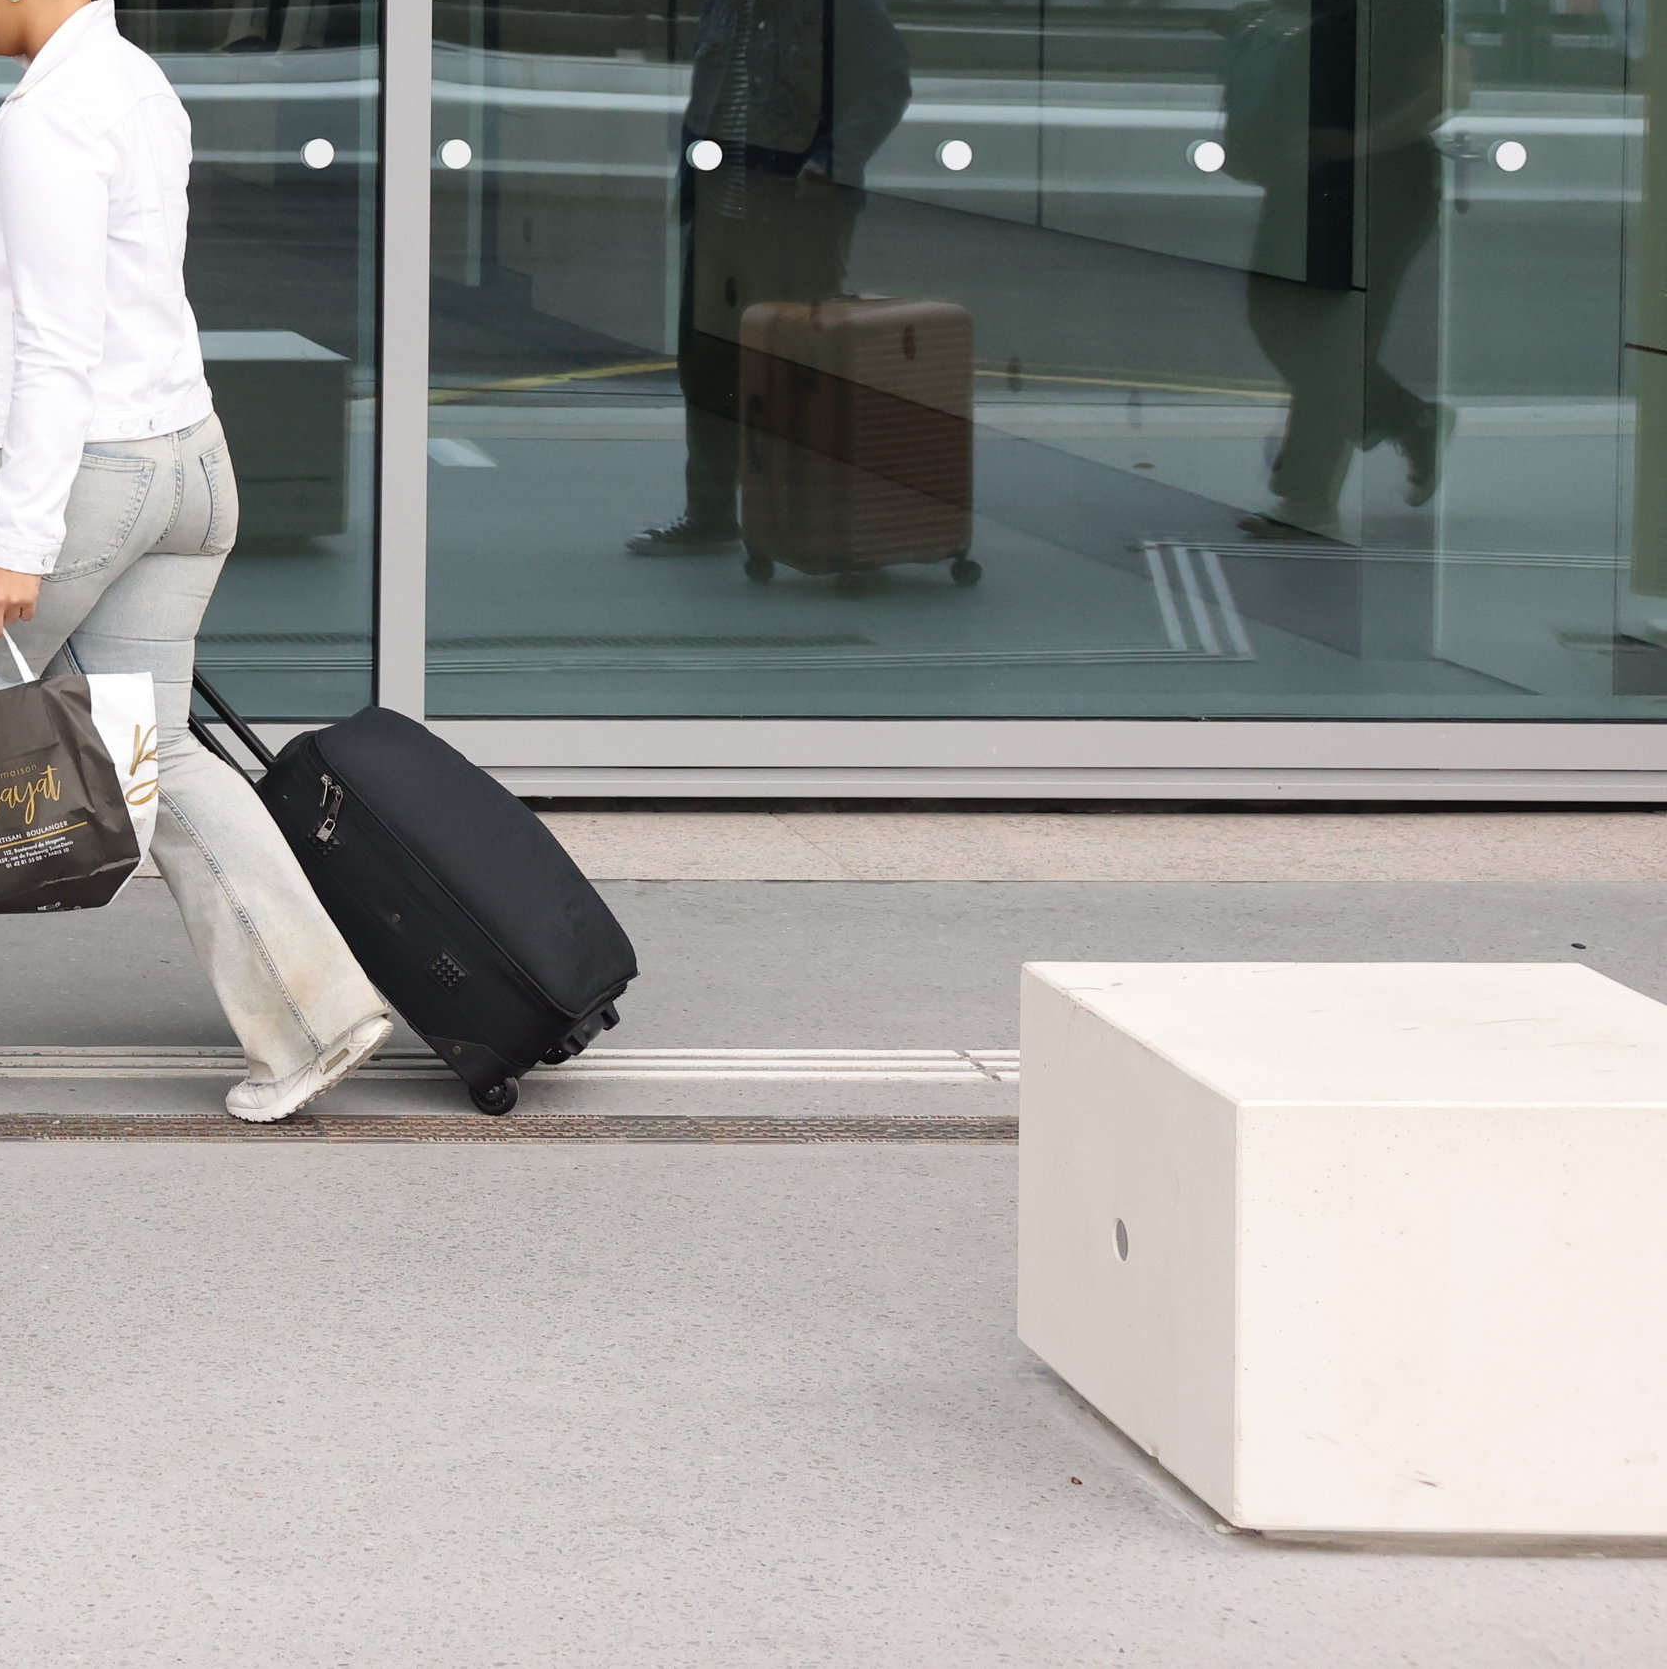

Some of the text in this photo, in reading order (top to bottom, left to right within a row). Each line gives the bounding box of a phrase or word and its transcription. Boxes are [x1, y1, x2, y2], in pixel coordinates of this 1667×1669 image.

[0, 764, 37, 779] maison
[26, 820, 69, 838] BOULANGER
[13, 843, 38, 854] Boulevard
[26, 848, 49, 858] Faubourg
[48, 850, 62, 858] PARIS
